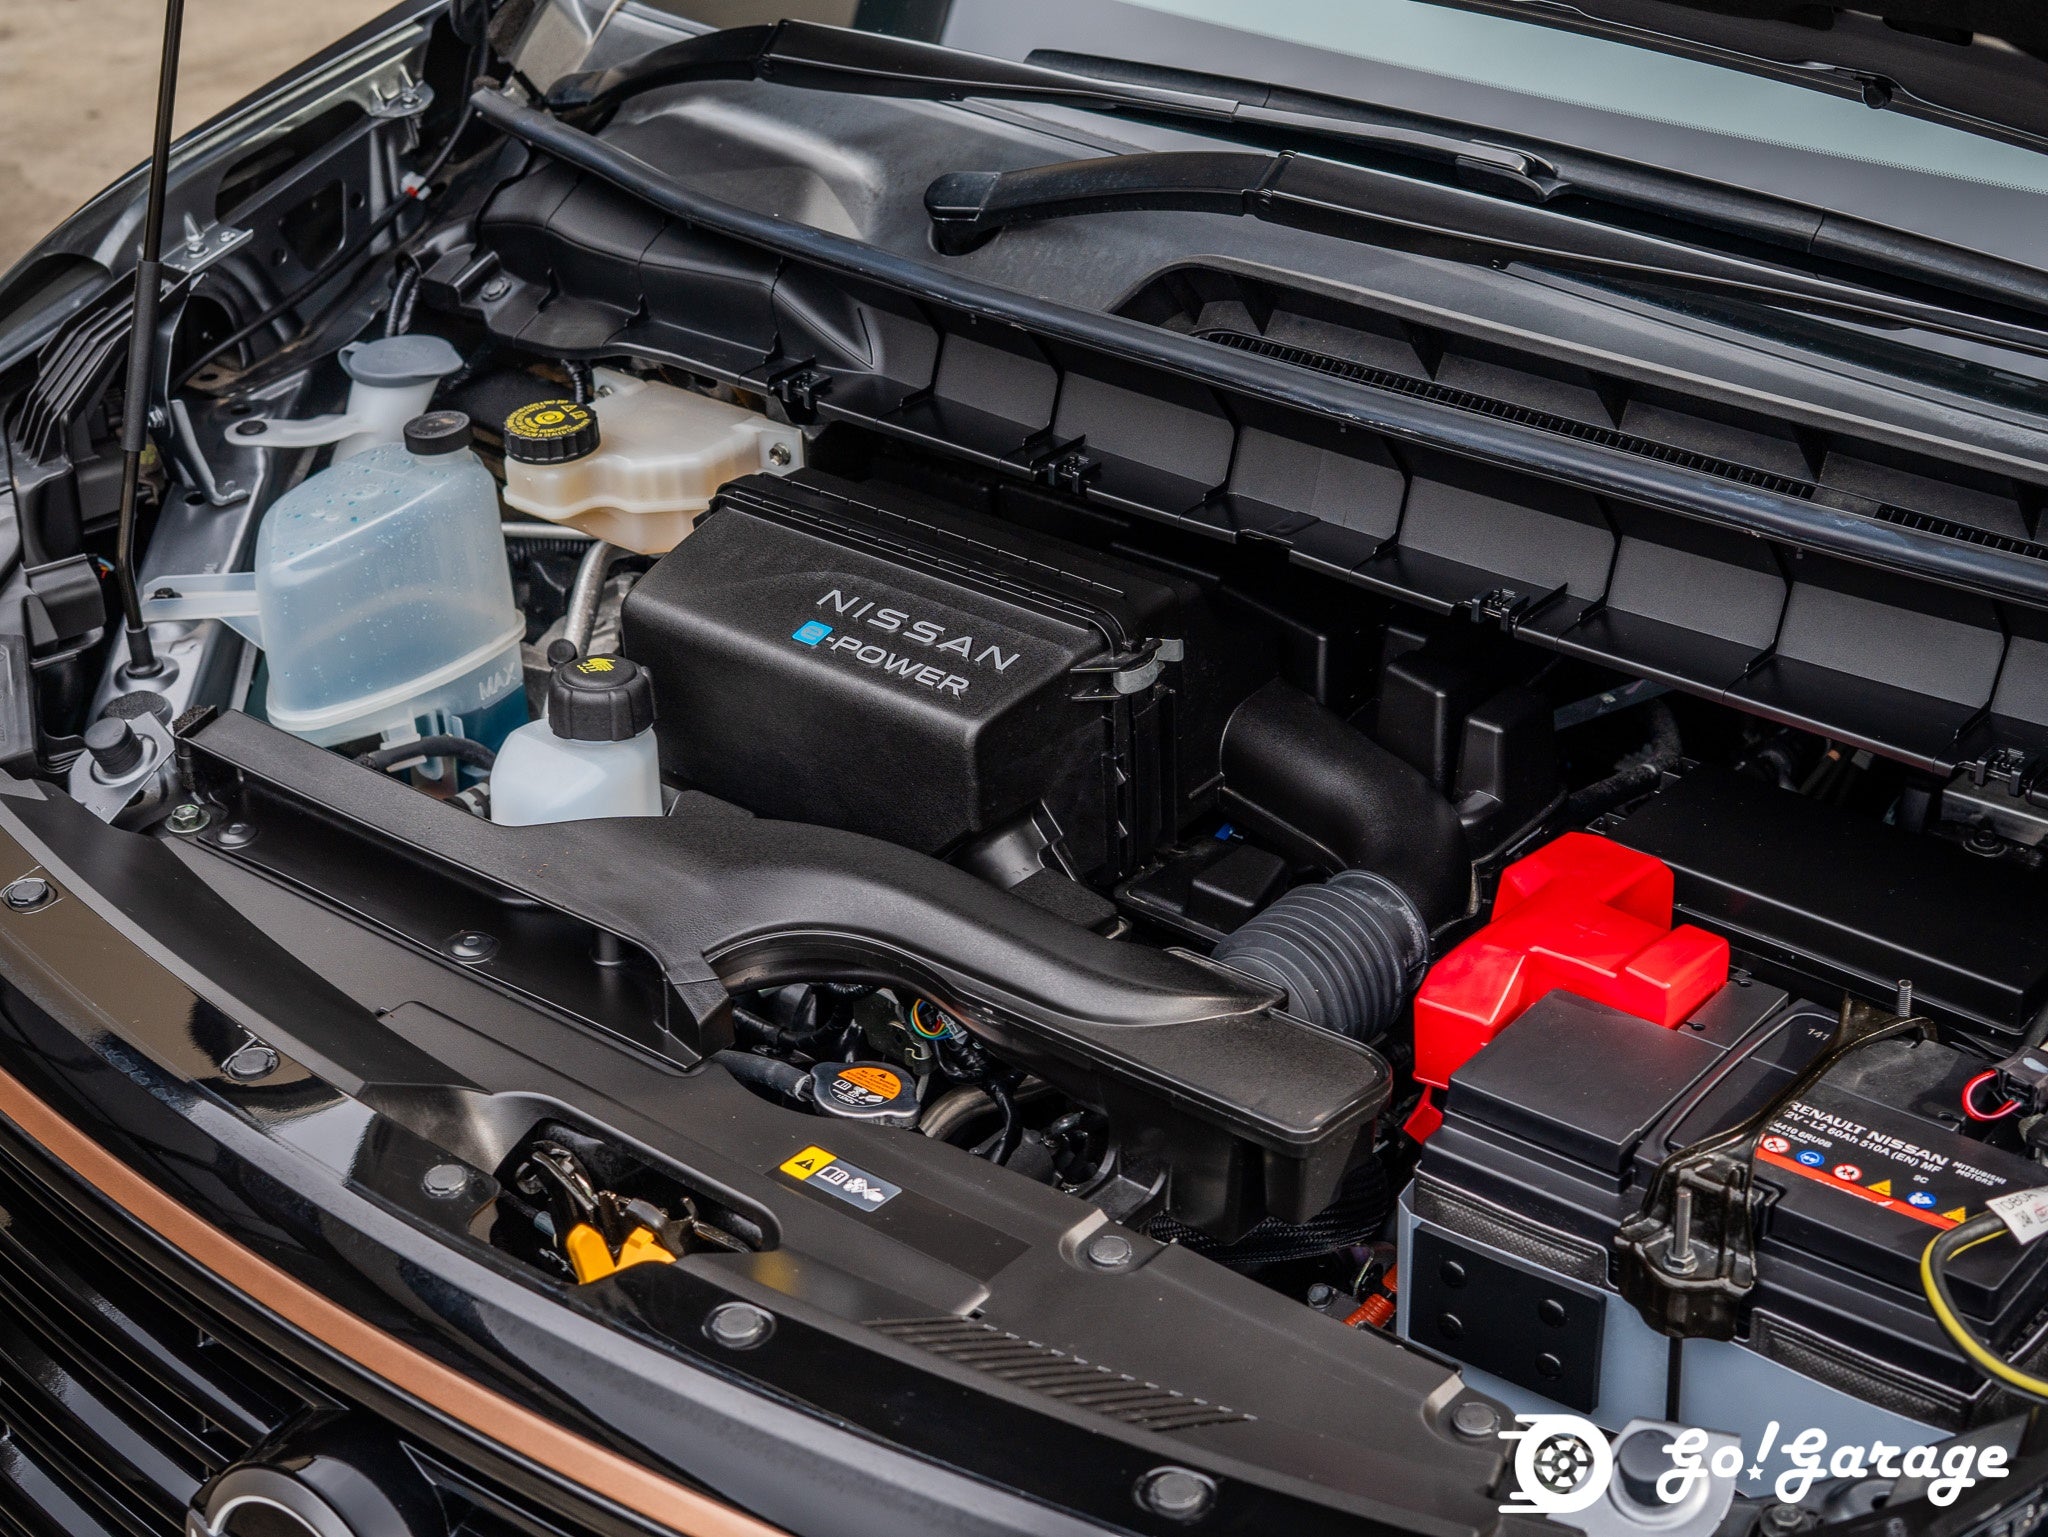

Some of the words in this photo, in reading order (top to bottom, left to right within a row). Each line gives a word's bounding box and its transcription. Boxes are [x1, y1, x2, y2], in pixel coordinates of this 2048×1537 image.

[816, 589, 1021, 671] NISSAN
[479, 661, 517, 700] MAX
[793, 620, 970, 696] e-POWER
[1790, 1101, 1867, 1134] RENAULT
[1866, 1130, 1950, 1166] NISSAN
[1809, 1120, 1828, 1132] L2
[1827, 1127, 1859, 1144] 60Ah
[1859, 1139, 1891, 1156] 510A
[1890, 1151, 1920, 1167] (EN)
[1919, 1161, 1943, 1173] MF
[1951, 1160, 2007, 1185] MITSUBISHI
[1955, 1168, 1994, 1186] MOTORS
